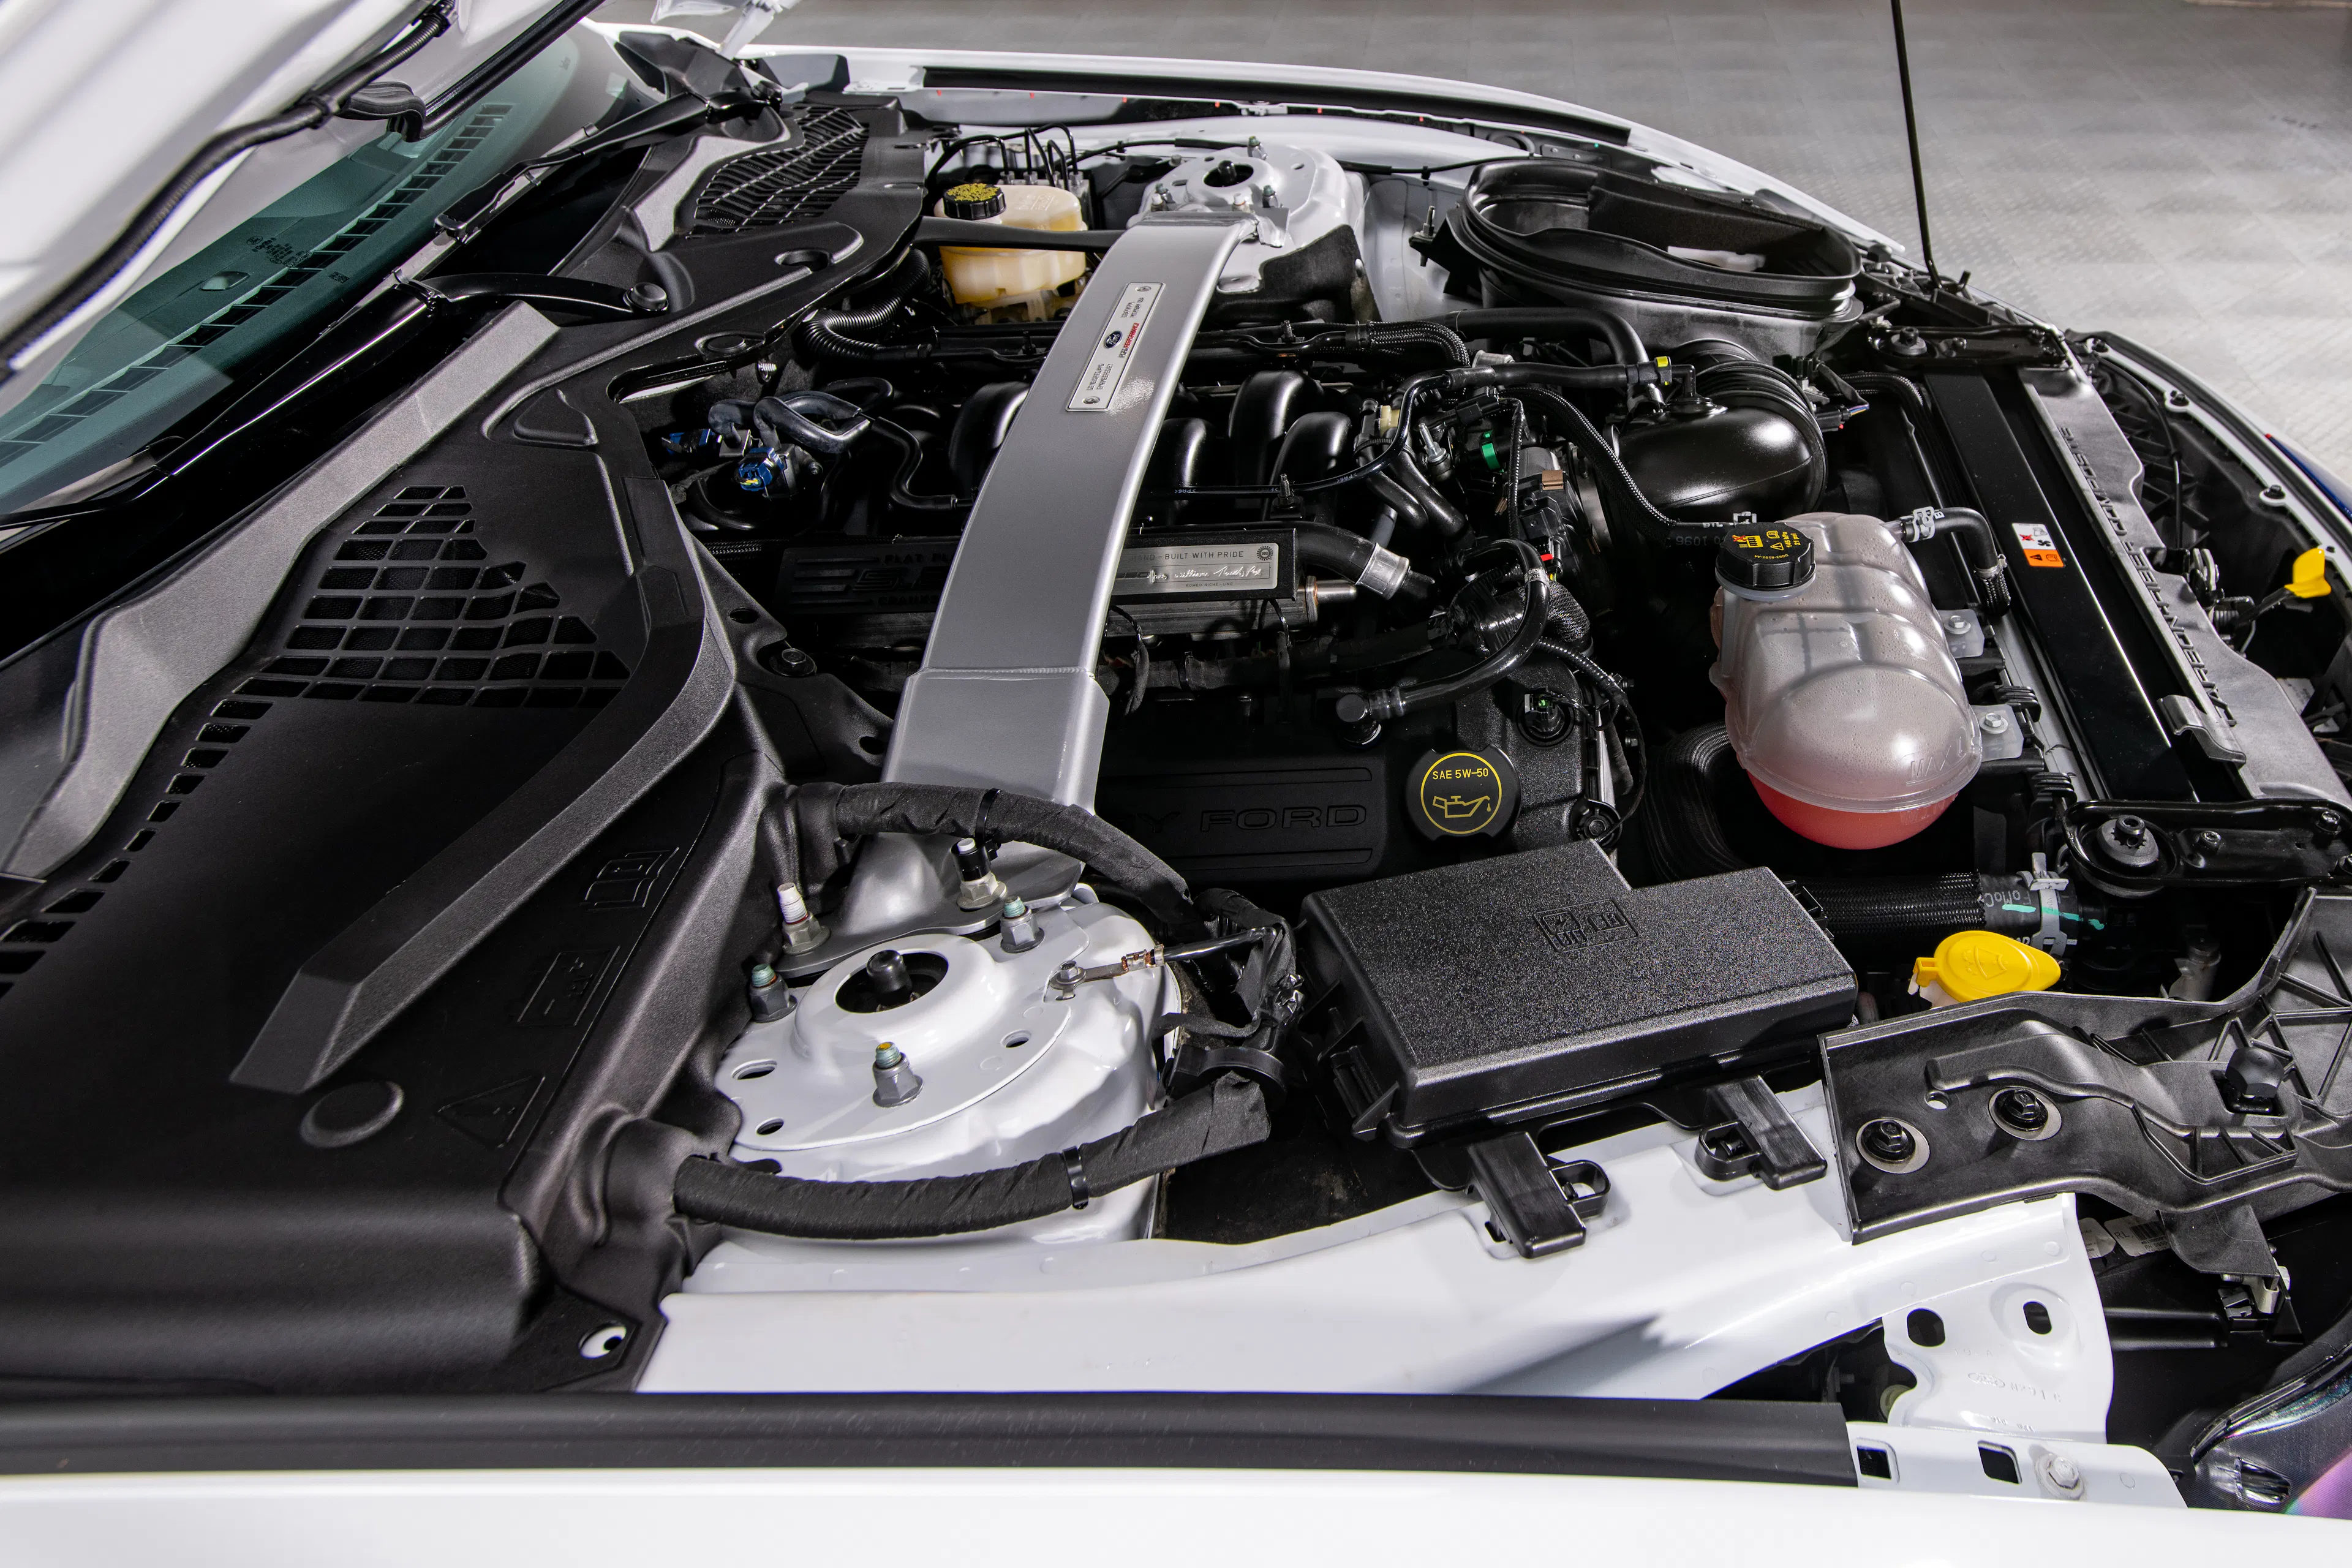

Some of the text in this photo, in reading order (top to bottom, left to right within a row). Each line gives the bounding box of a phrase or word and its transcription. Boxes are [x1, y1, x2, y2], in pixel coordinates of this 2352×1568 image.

[1433, 767, 1489, 780] SAE 5W-50
[1199, 804, 1366, 833] FORD
